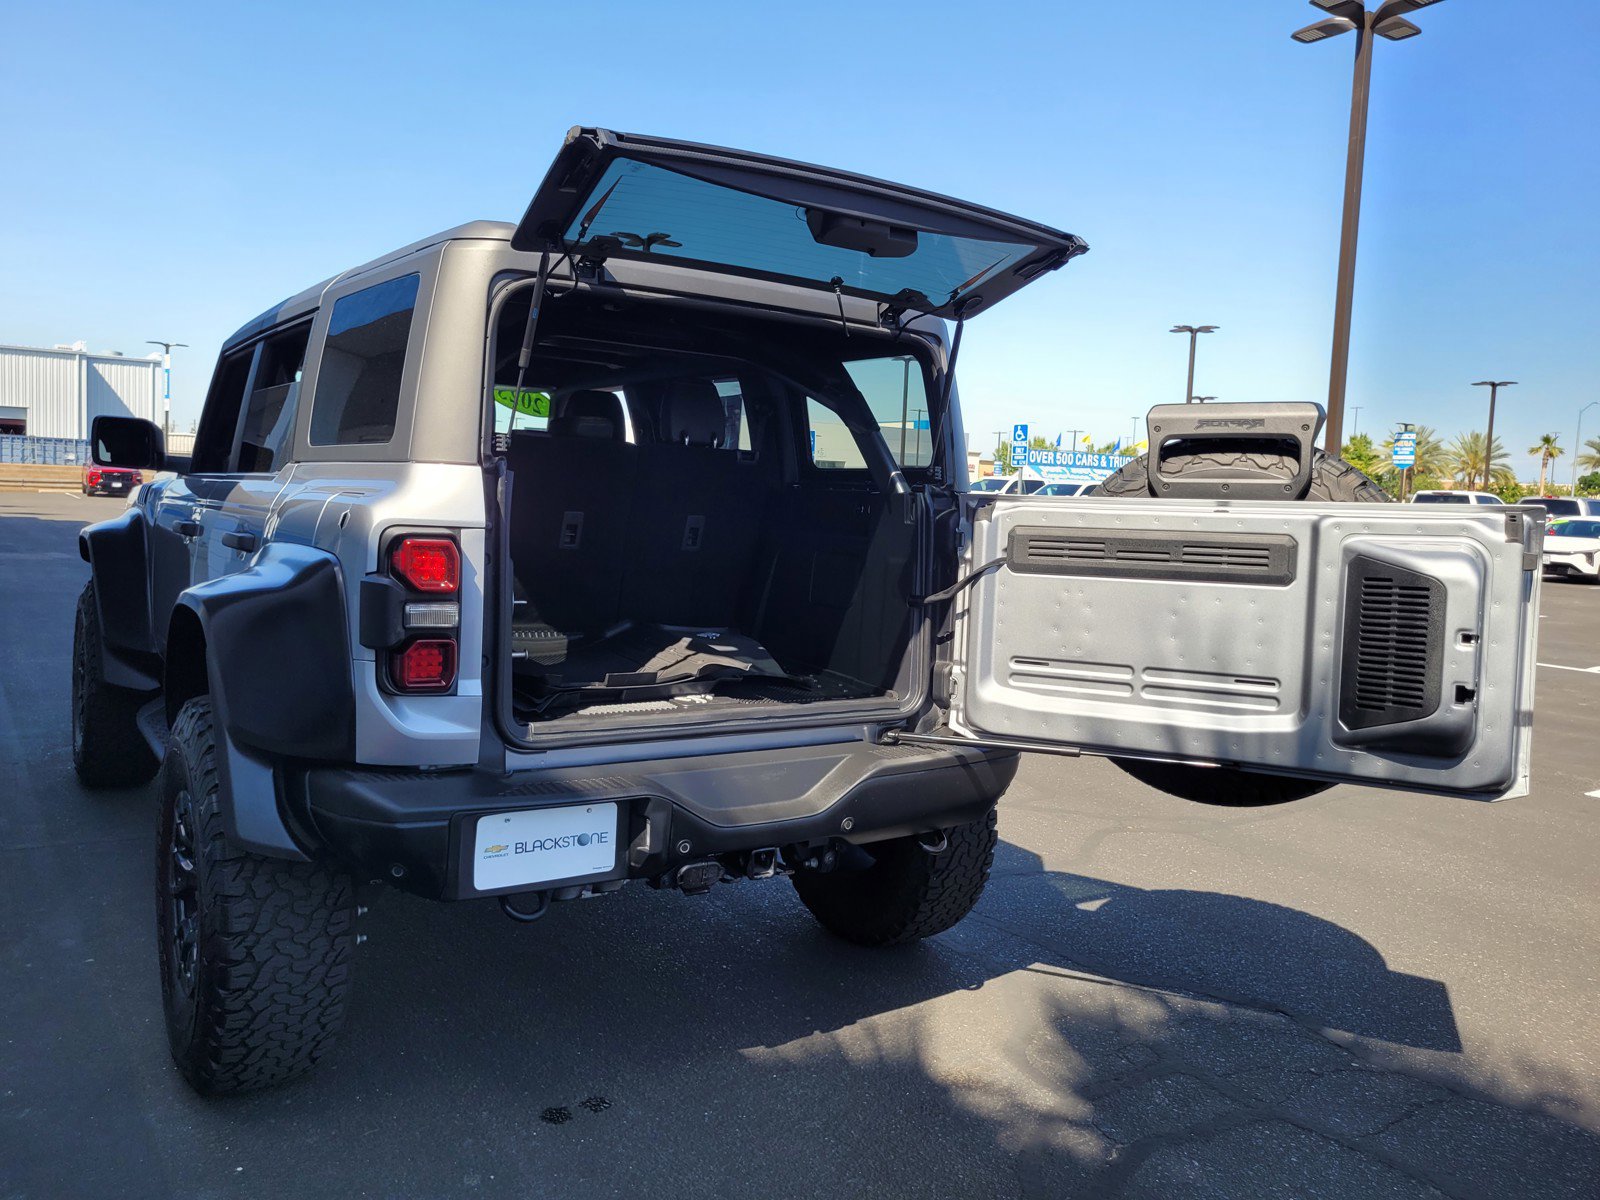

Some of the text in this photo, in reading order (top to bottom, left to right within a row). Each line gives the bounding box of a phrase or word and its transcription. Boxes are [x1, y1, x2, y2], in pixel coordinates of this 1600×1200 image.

[1029, 450, 1054, 464] OVER
[1056, 451, 1074, 465] 500
[1075, 452, 1099, 467] CARS
[1100, 454, 1107, 468] &
[1109, 456, 1135, 468] TRUC
[514, 832, 609, 855] BLACKSTONE
